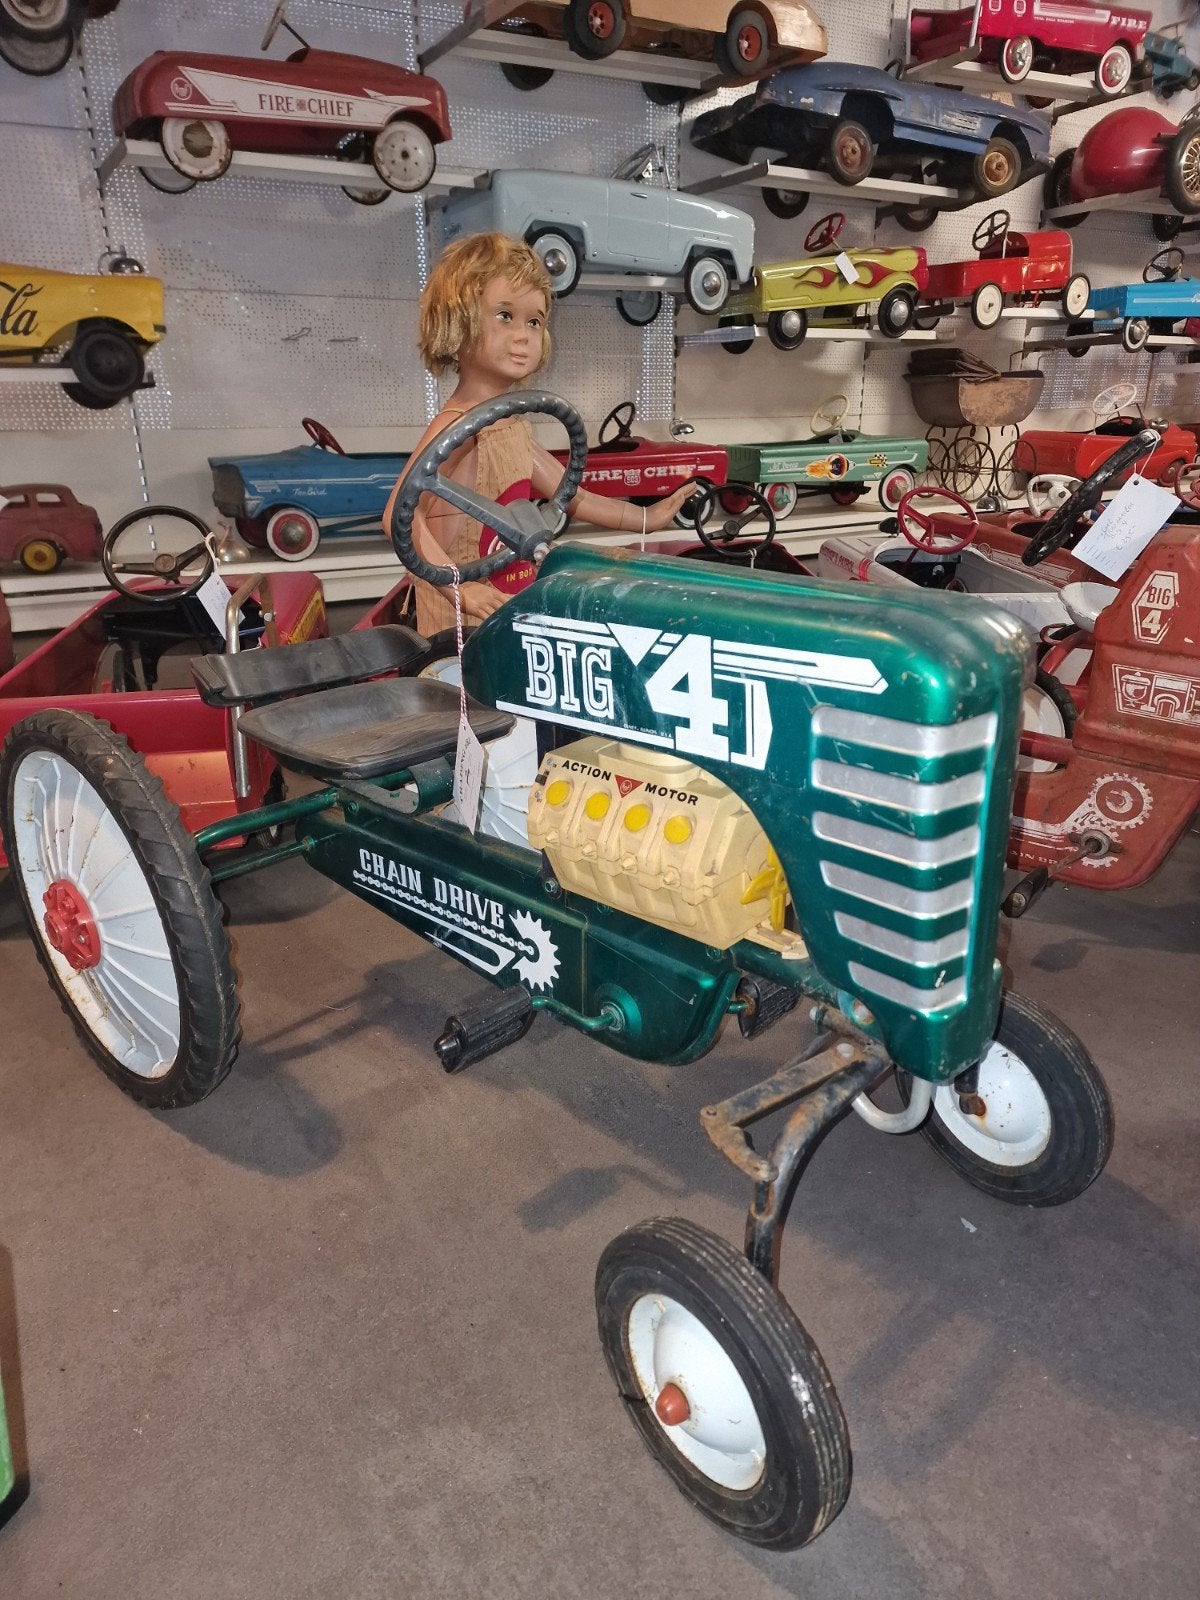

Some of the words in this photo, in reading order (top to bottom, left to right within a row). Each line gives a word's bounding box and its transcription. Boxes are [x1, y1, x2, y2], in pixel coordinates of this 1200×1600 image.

[1110, 15, 1147, 30] FIRE
[258, 93, 294, 113] FIRE
[306, 98, 354, 117] CHIEF
[582, 469, 623, 483] FIRE
[644, 463, 697, 479] CHIEF
[506, 573, 516, 582] IN
[1146, 586, 1171, 606] BIG
[1141, 609, 1162, 635] 4
[521, 634, 615, 720] BIG
[645, 633, 729, 762] 4
[562, 759, 611, 781] ACTION
[644, 783, 699, 806] MOTOR
[359, 848, 423, 894] CHAIN
[433, 877, 505, 930] DRIVE
